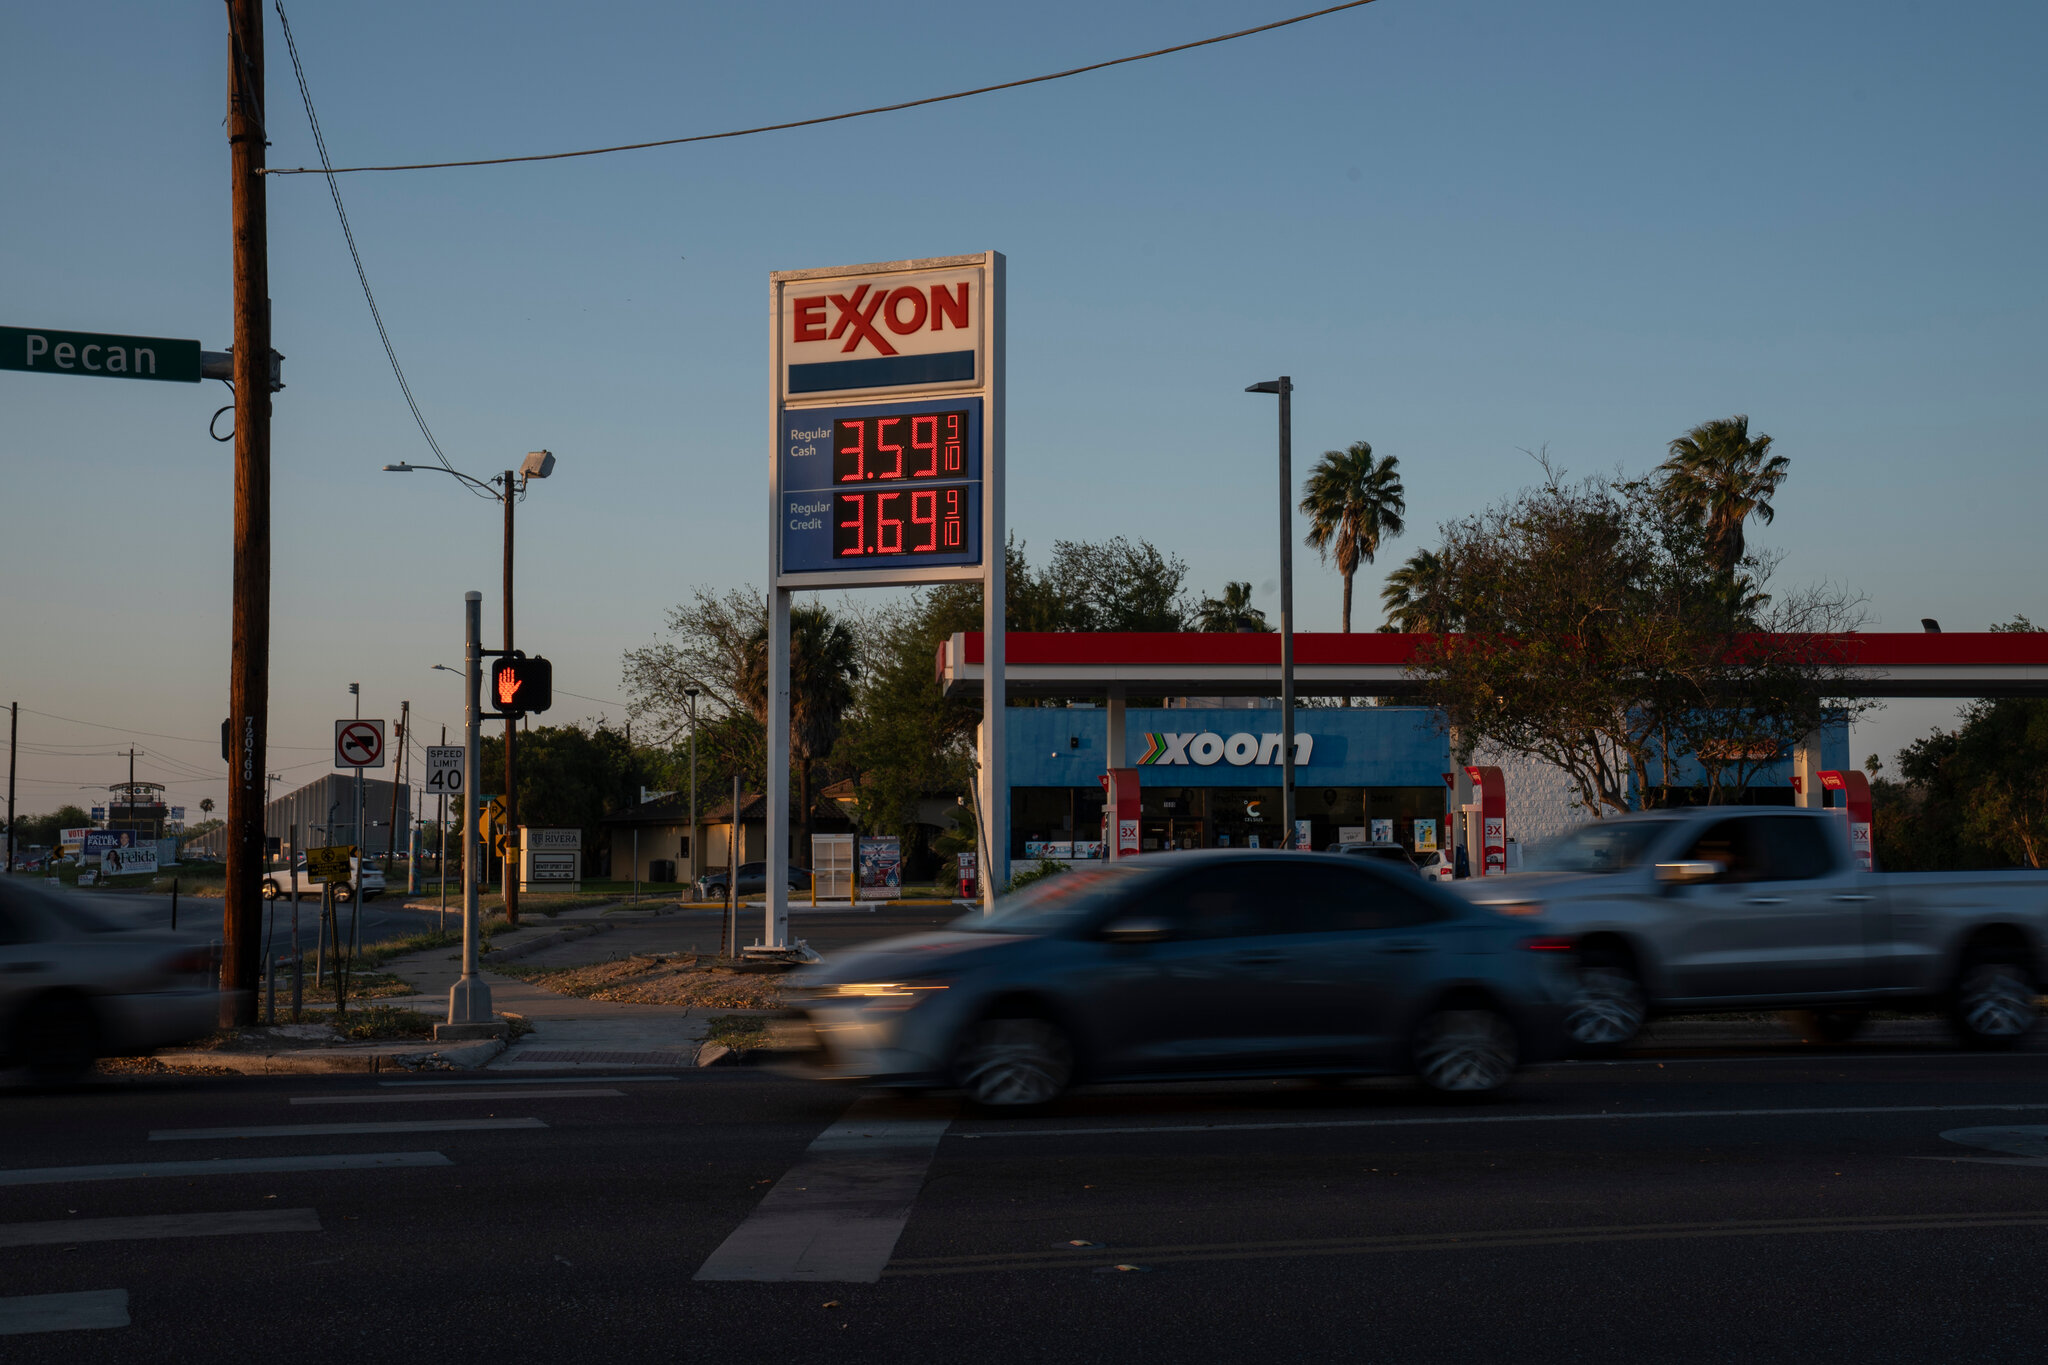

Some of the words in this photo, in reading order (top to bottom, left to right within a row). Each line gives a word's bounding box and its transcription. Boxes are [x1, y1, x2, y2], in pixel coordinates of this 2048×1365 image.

[793, 282, 969, 356] EXXON
[26, 334, 156, 374] Pecan
[790, 428, 832, 442] Regular
[790, 445, 816, 457] Cash
[840, 416, 938, 481] 3.59
[790, 501, 831, 516] Regular
[790, 518, 822, 530] Credit
[840, 490, 938, 555] 3.69
[244, 715, 254, 781] 720760
[430, 750, 462, 758] SPEED
[1154, 733, 1314, 766] xoom
[429, 770, 462, 790] 40
[68, 830, 83, 838] VOTE
[1121, 827, 1136, 837] 3X
[1487, 825, 1502, 835] 3X
[1853, 830, 1868, 840] 3X
[545, 835, 577, 843] RIVERA
